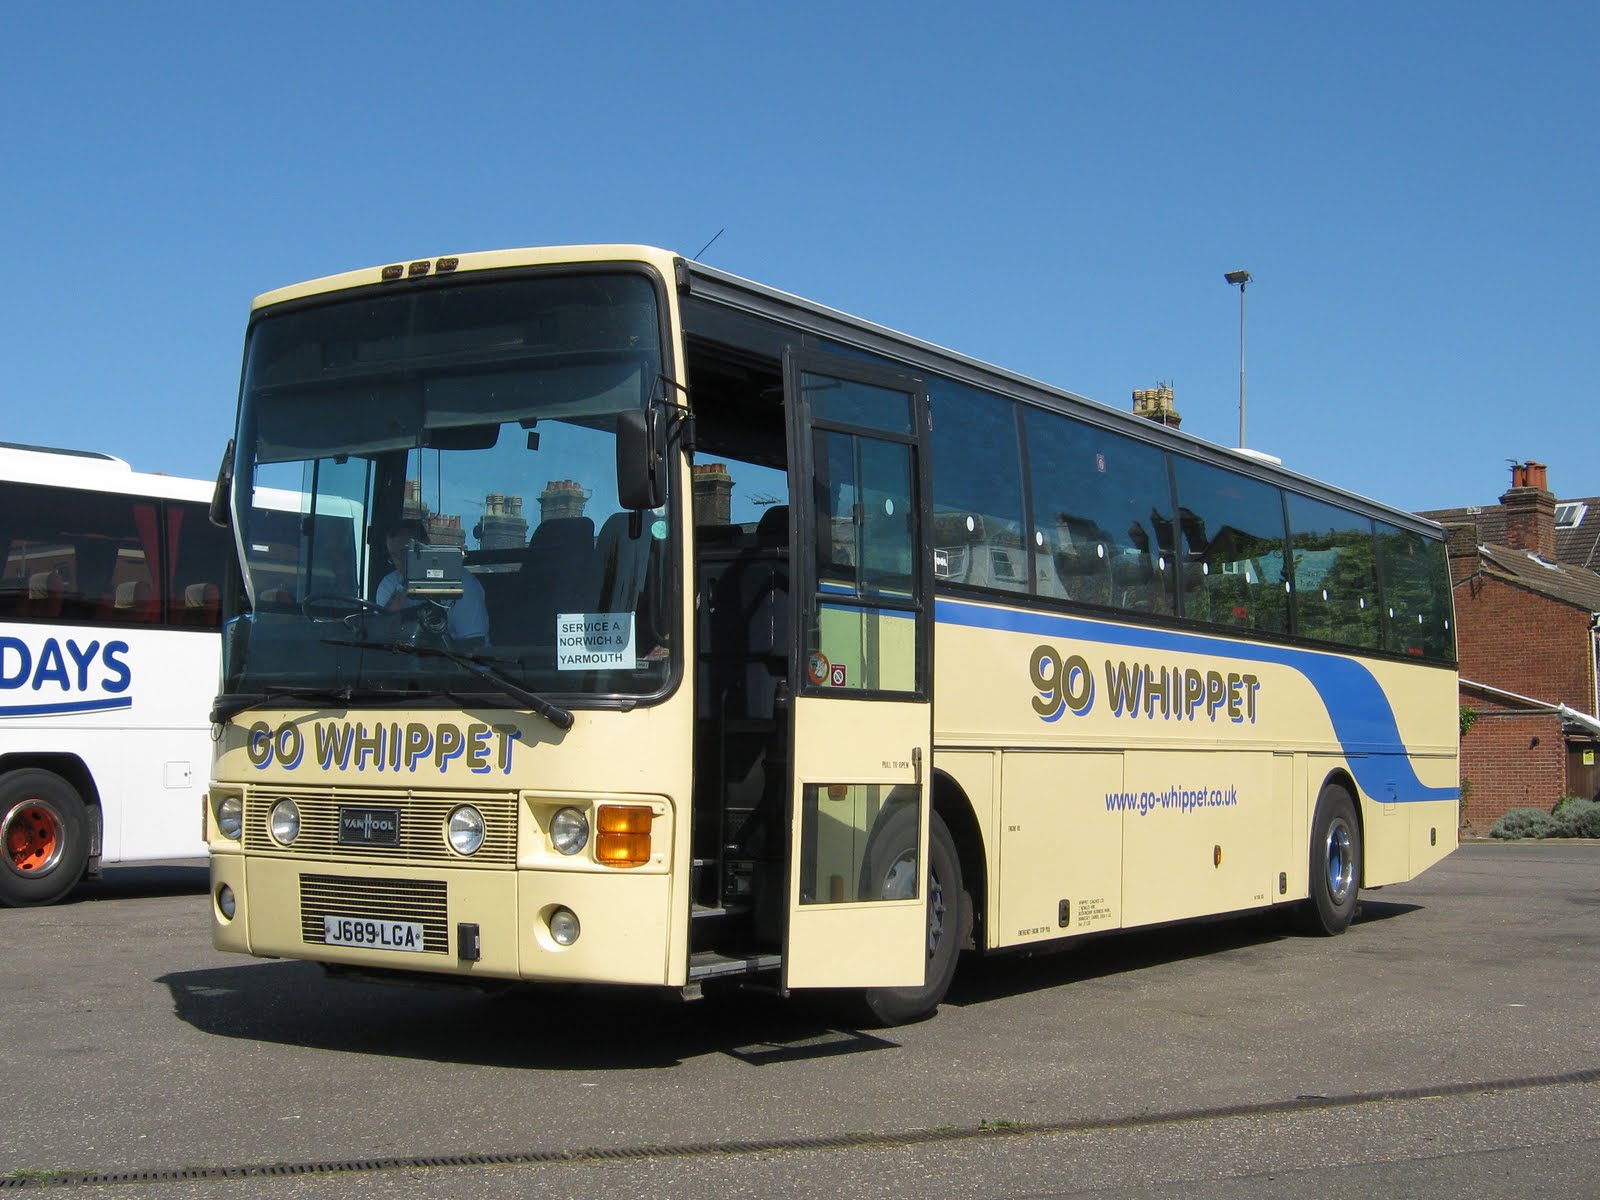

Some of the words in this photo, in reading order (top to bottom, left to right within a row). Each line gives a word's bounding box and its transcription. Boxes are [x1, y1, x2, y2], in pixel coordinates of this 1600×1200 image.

[560, 636, 611, 646] NORWICH
[616, 635, 624, 644] &
[562, 622, 608, 632] SERVICE
[612, 622, 621, 631] A
[0, 636, 131, 693] DAYS
[560, 653, 622, 664] YARMOUTH
[1105, 660, 1260, 724] WHIPPET
[247, 721, 304, 770] GO
[314, 722, 522, 775] WHIPPET
[898, 761, 909, 769] OPEN
[1105, 784, 1237, 816] www.go-whippet.co.uk
[333, 920, 376, 943] J689
[381, 924, 415, 947] LGA
